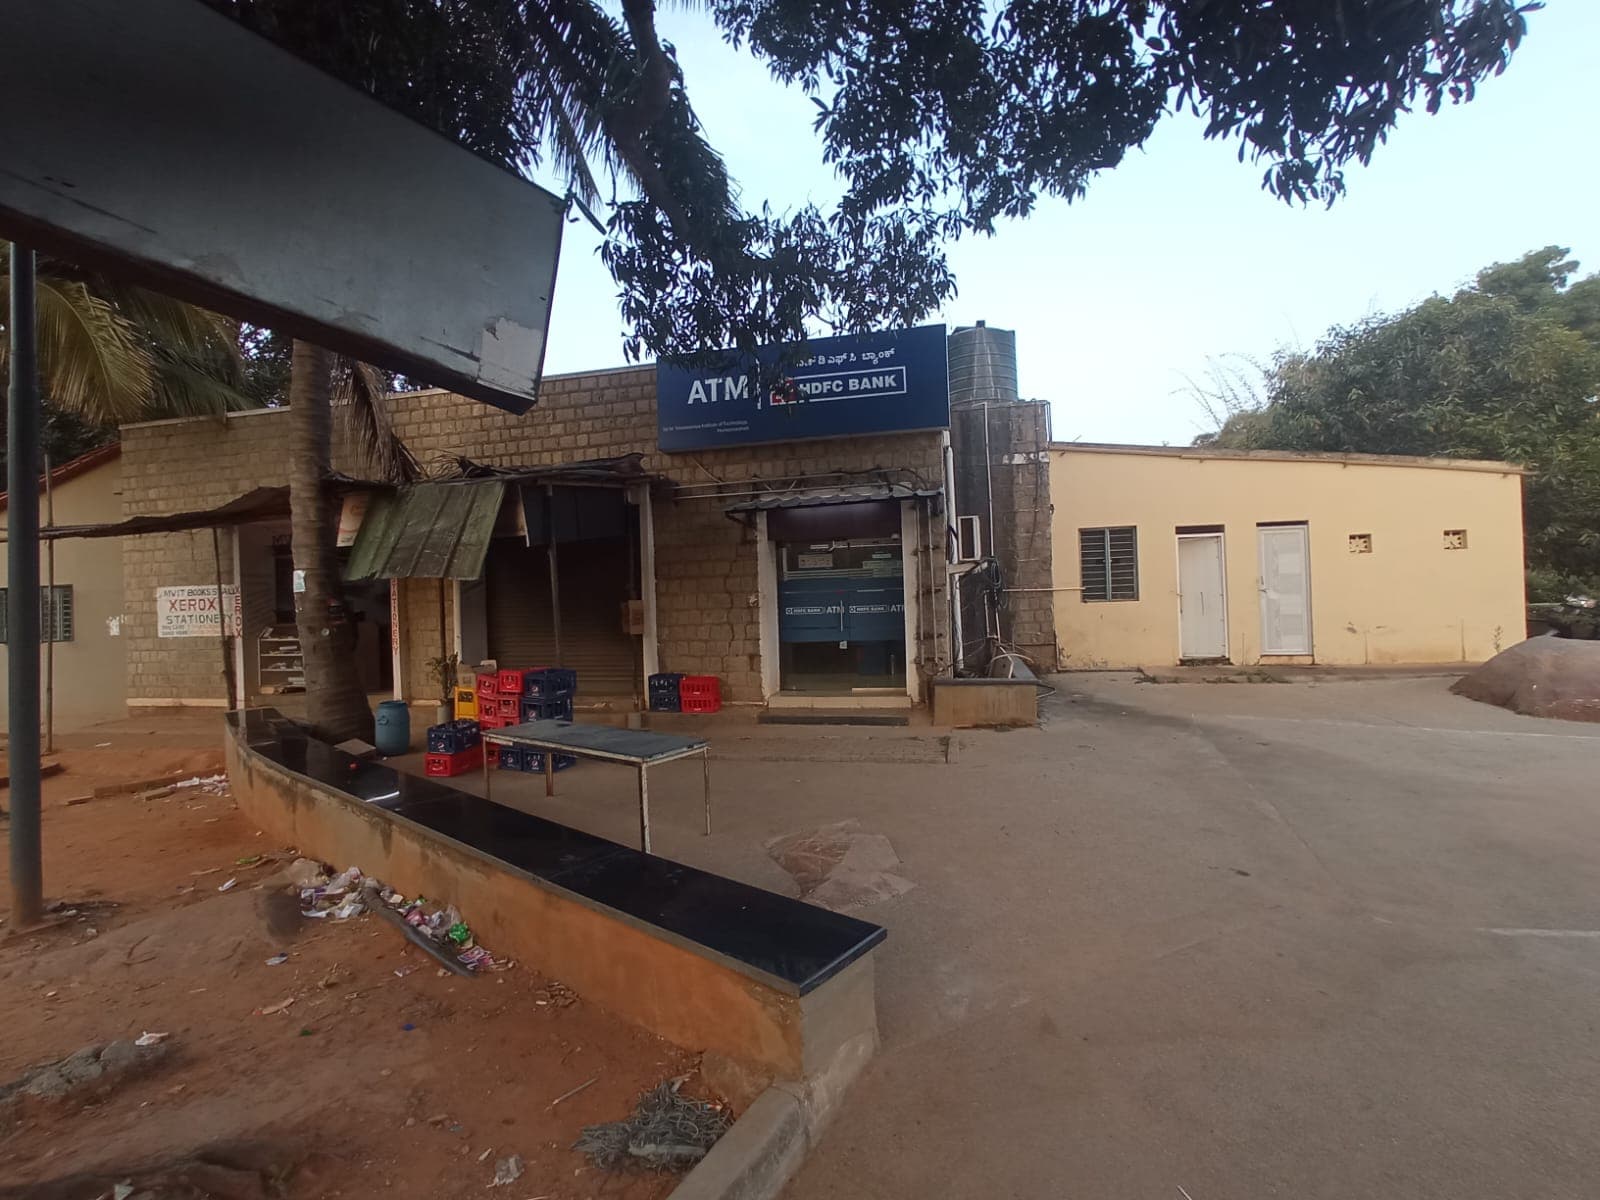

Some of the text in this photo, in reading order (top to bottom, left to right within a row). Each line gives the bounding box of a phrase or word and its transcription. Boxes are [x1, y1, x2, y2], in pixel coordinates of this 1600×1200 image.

[687, 374, 749, 404] ATM
[799, 374, 897, 395] HDFC BANK
[168, 598, 217, 612] XEROX
[166, 614, 233, 624] STATIONEY
